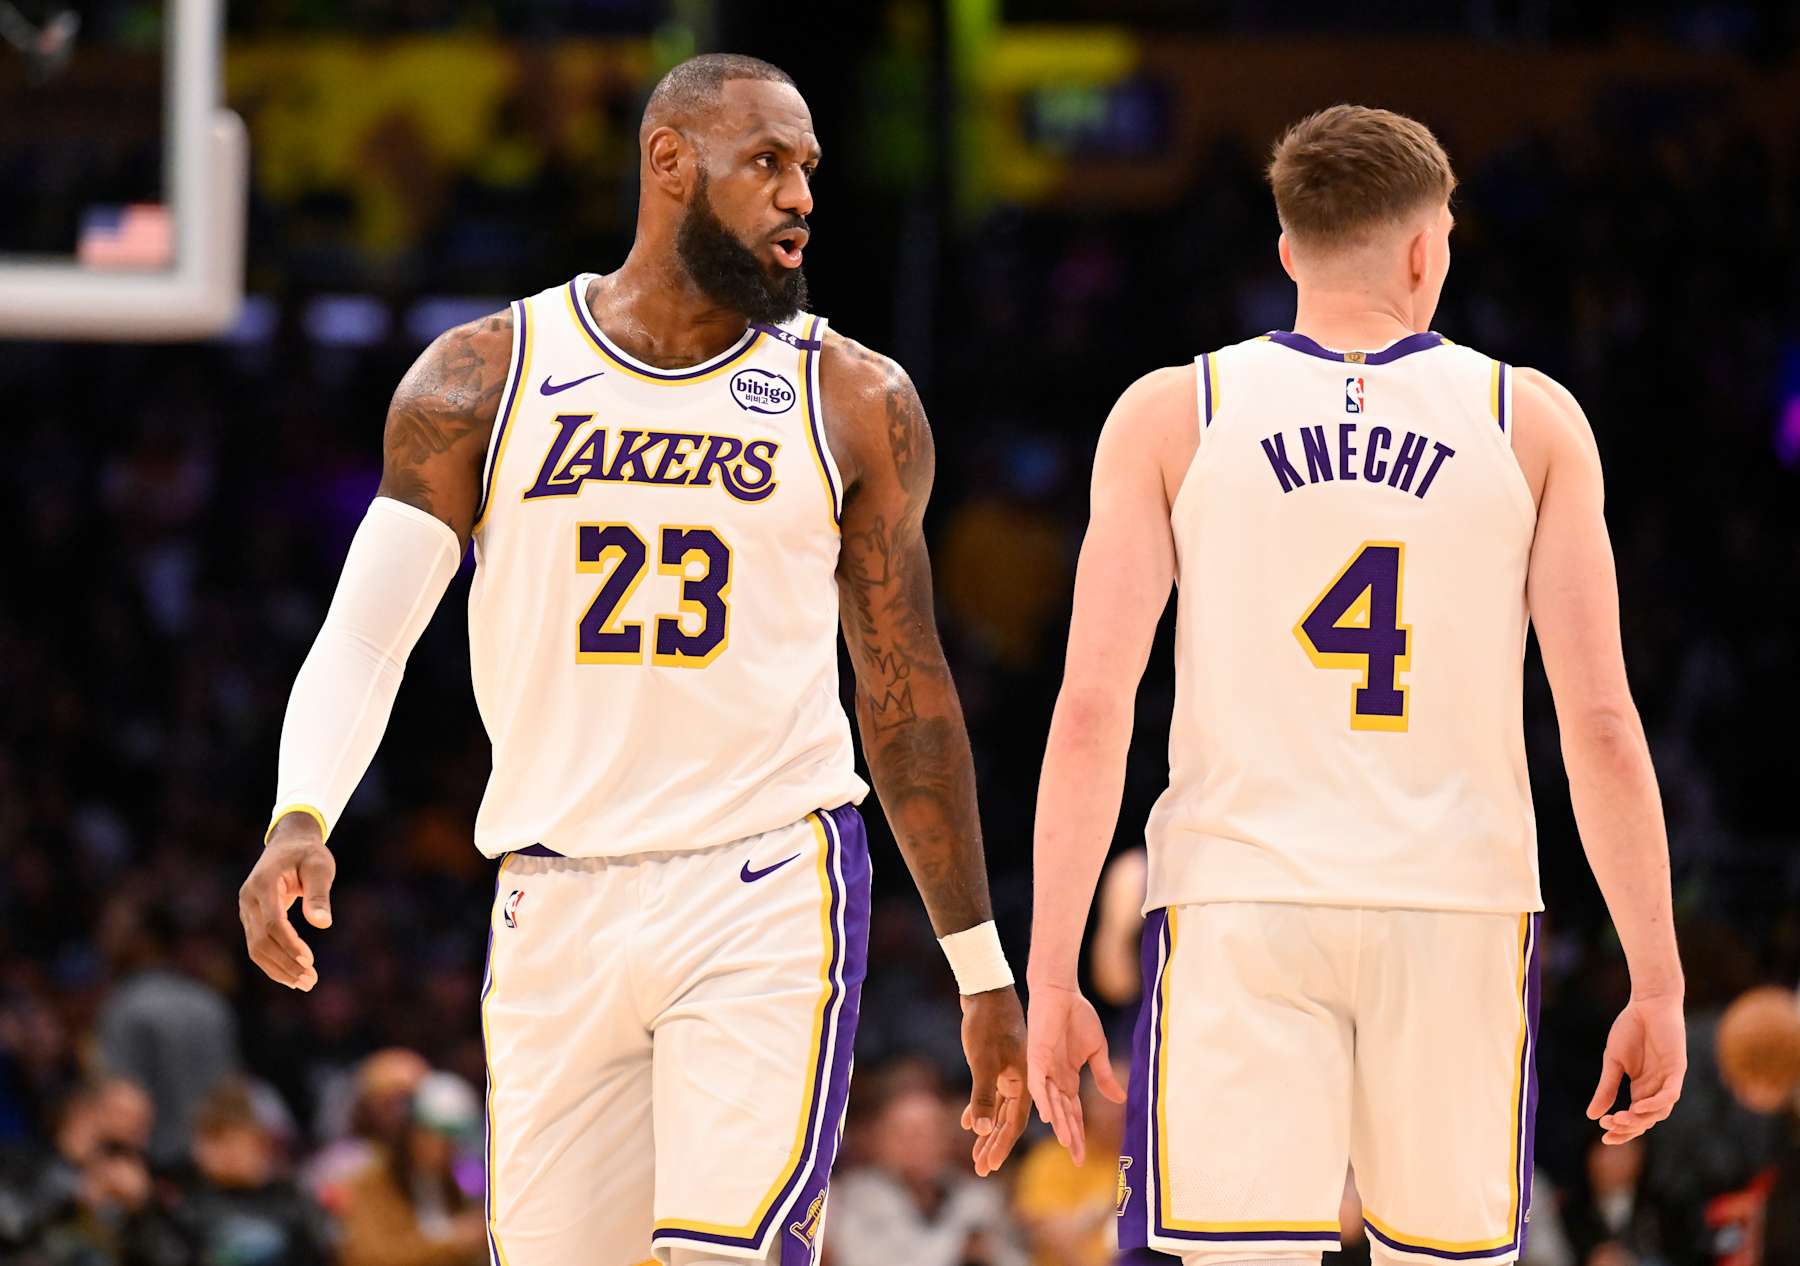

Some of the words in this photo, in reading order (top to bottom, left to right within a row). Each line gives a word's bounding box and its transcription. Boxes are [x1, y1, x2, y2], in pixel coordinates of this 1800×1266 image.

[778, 332, 797, 346] 44
[736, 378, 792, 403] bibigo
[522, 412, 780, 503] LAKERS
[1261, 423, 1456, 499] KNECHT
[575, 521, 734, 669] 23
[1293, 540, 1412, 732] 4
